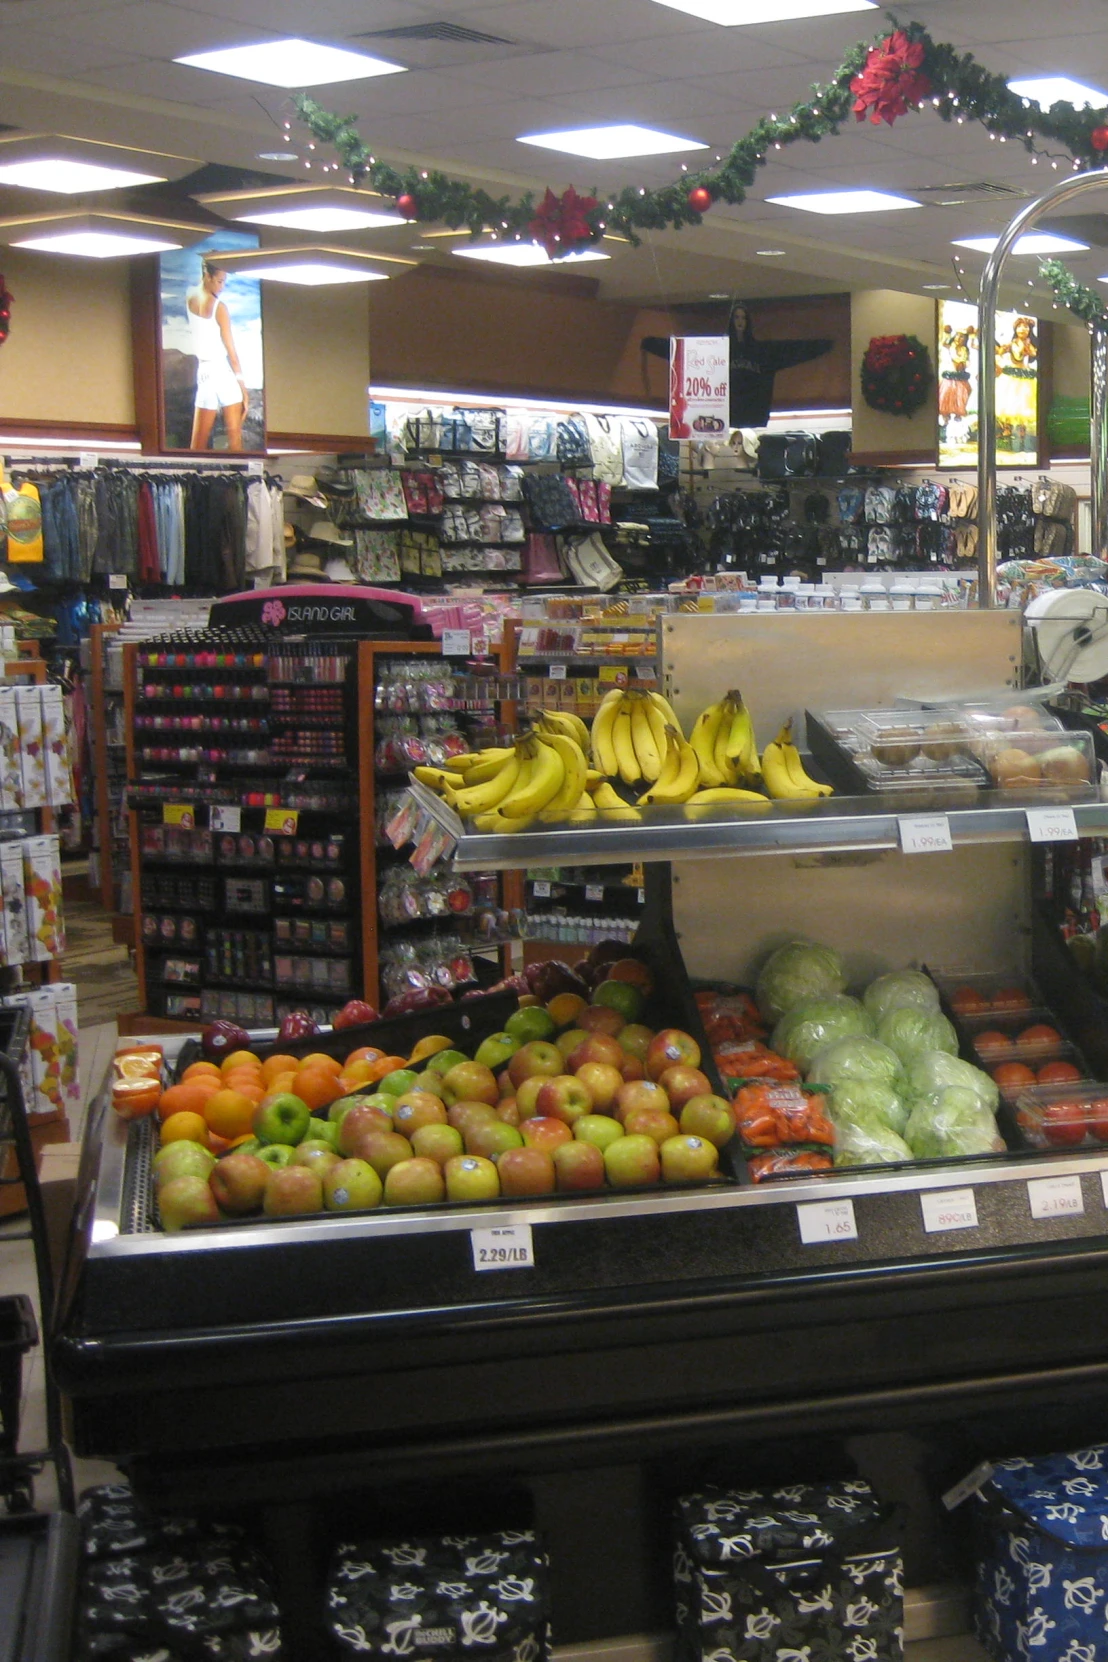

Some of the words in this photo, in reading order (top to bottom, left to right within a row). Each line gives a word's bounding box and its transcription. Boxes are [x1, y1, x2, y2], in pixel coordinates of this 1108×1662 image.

[687, 350, 704, 370] Red
[706, 355, 726, 375] Sale
[686, 377, 712, 397] 20%
[714, 382, 727, 396] off
[288, 607, 329, 621] ISLAND
[331, 607, 357, 621] GIRL
[1042, 1198, 1078, 1211] 2.19/LB
[825, 1222, 851, 1235] 1.65
[479, 1248, 528, 1263] 2.29/LB
